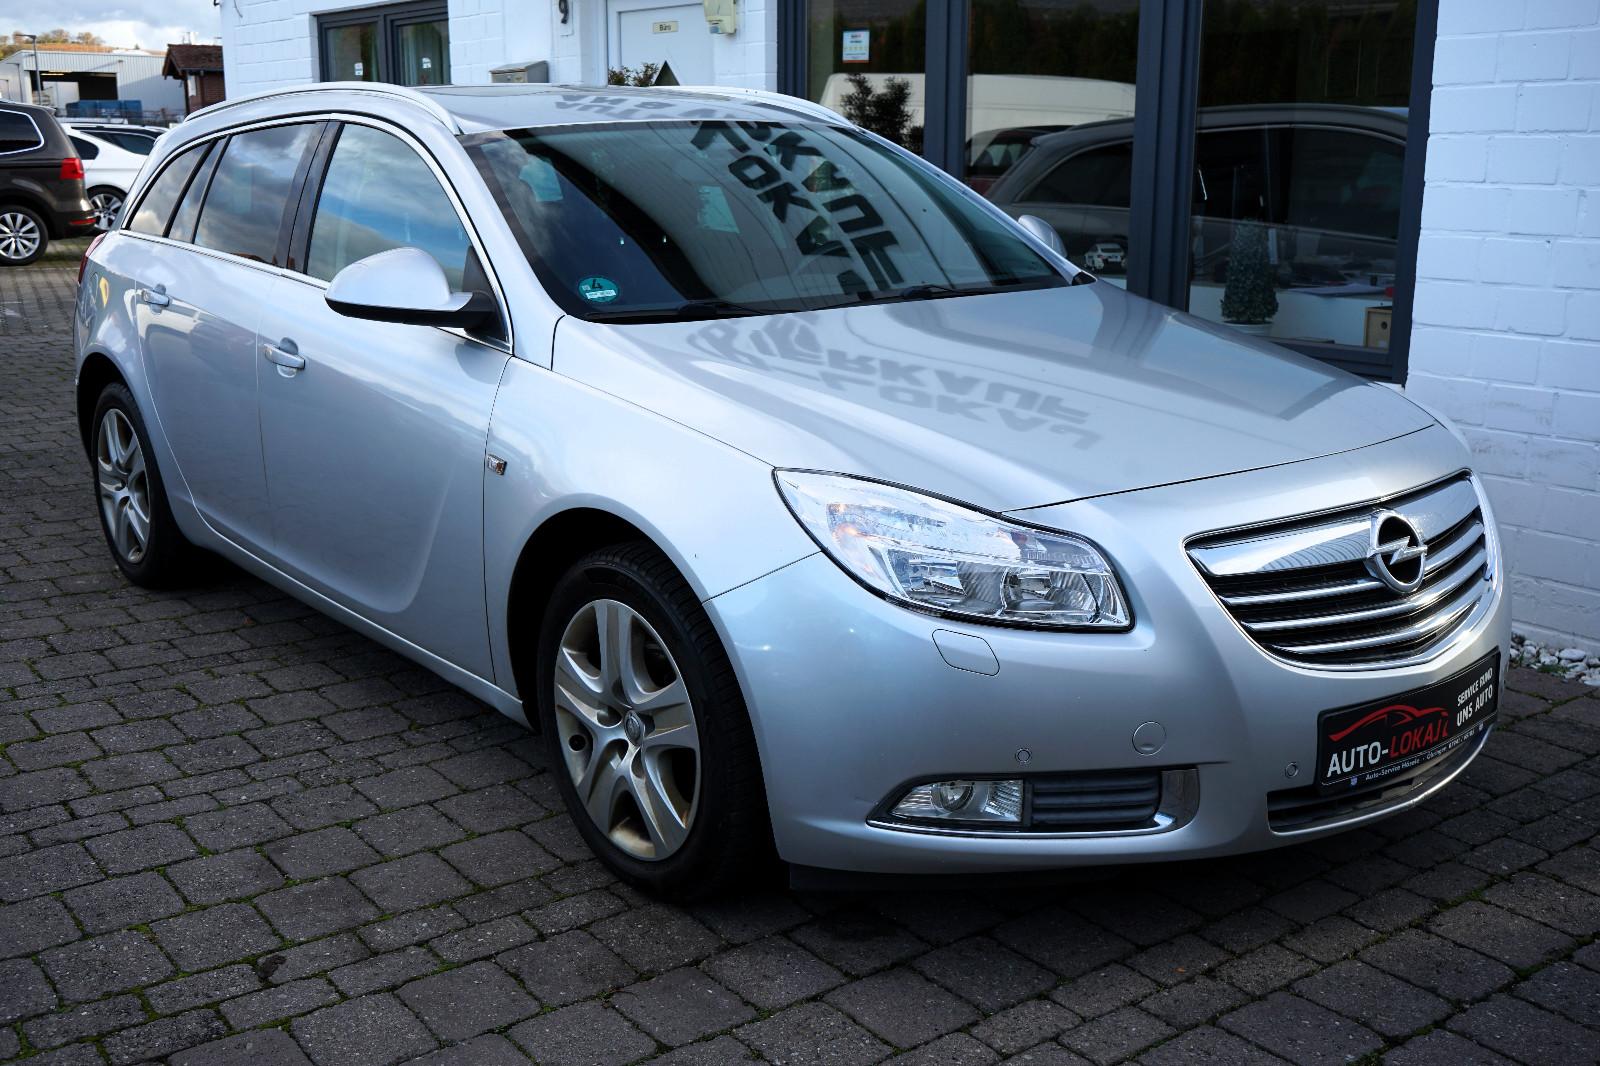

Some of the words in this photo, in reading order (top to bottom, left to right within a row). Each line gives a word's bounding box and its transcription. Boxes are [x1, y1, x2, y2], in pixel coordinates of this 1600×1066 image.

[659, 23, 672, 31] Büro
[591, 279, 603, 289] 4
[1457, 681, 1479, 707] SERVICE
[1479, 667, 1493, 687] RUND
[1456, 707, 1473, 727] UMS
[1474, 684, 1493, 711] AUTO
